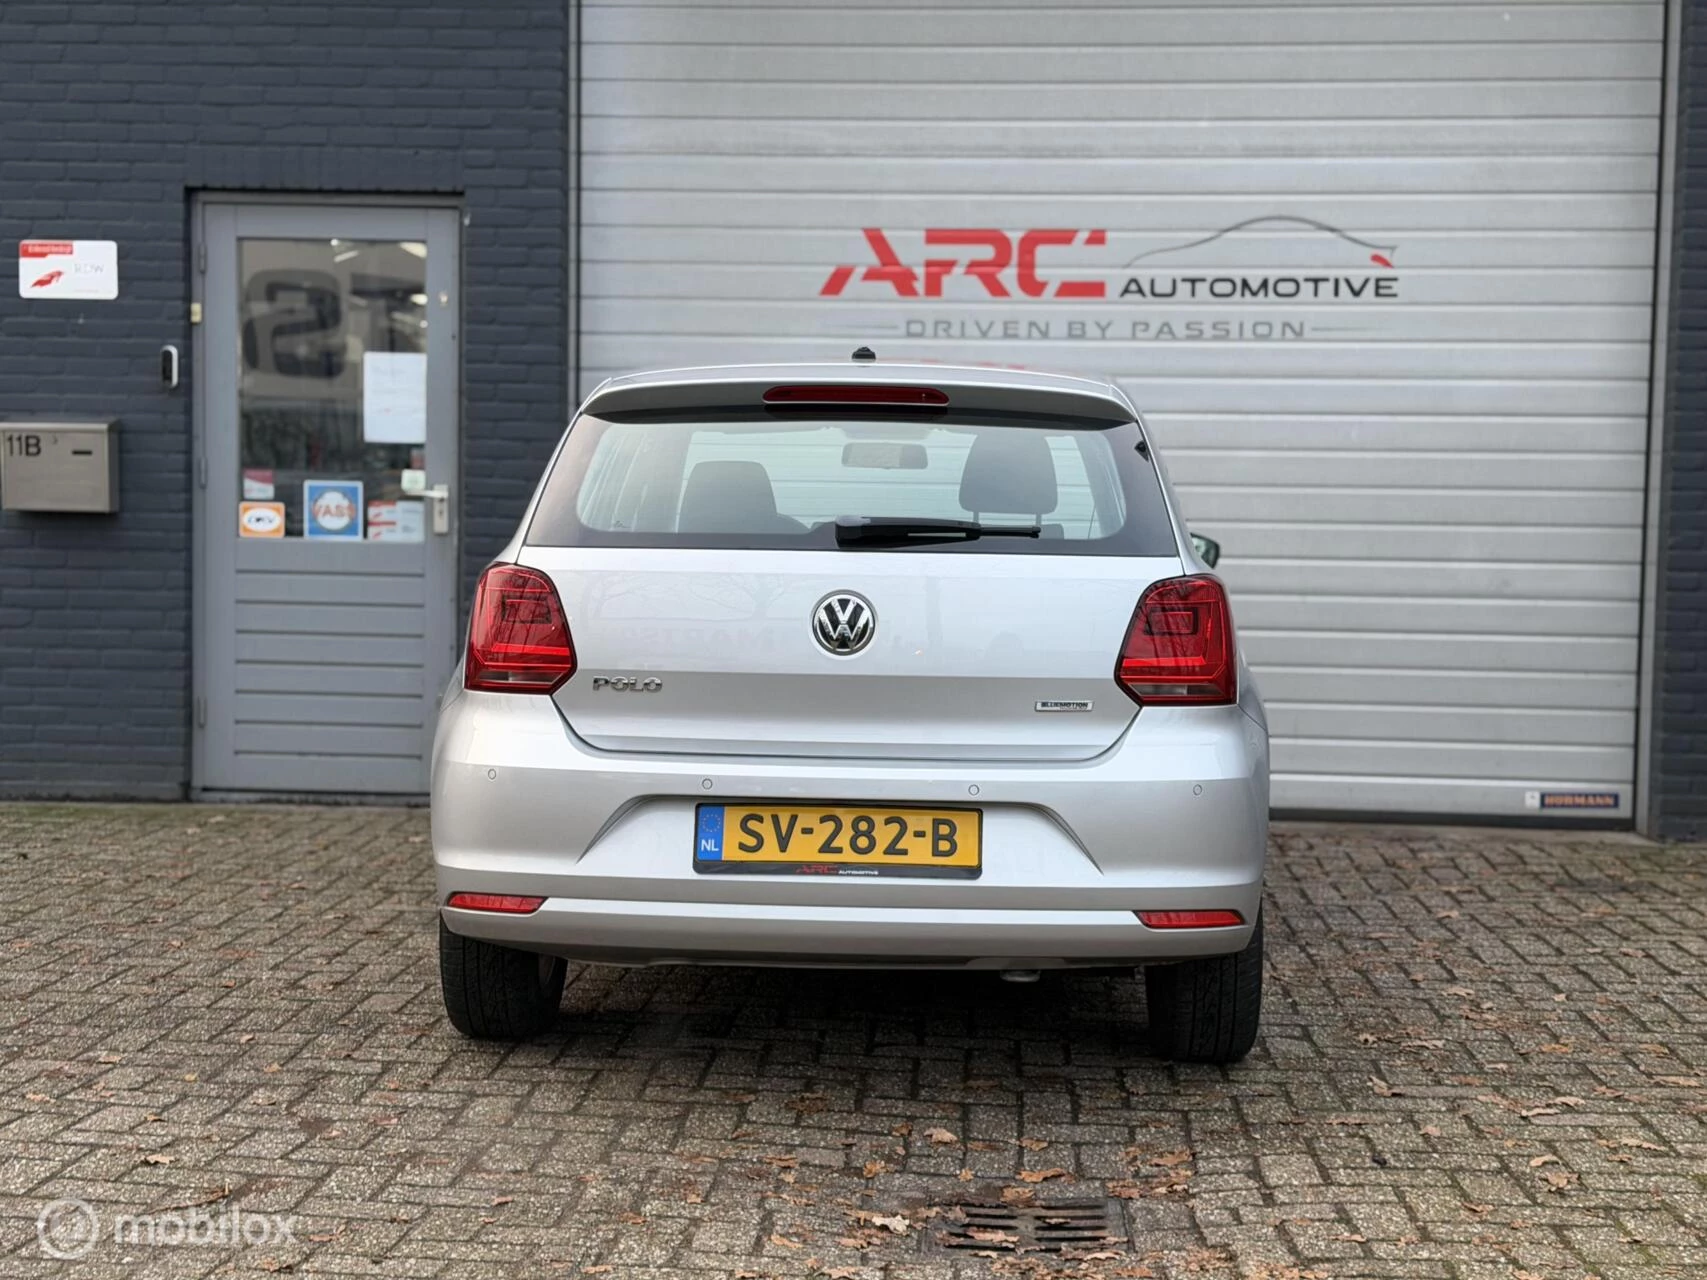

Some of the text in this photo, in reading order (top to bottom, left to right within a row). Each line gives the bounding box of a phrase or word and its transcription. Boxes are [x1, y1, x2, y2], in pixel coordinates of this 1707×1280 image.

[819, 228, 1106, 297] ARC
[1119, 278, 1398, 298] AUTOMOTIVE
[906, 319, 1304, 339] DRIVEN BY PASSION
[7, 434, 42, 457] 11B
[593, 676, 662, 693] POLO
[701, 839, 719, 851] NL
[738, 814, 958, 857] SV-282-B
[796, 864, 838, 874] ARC
